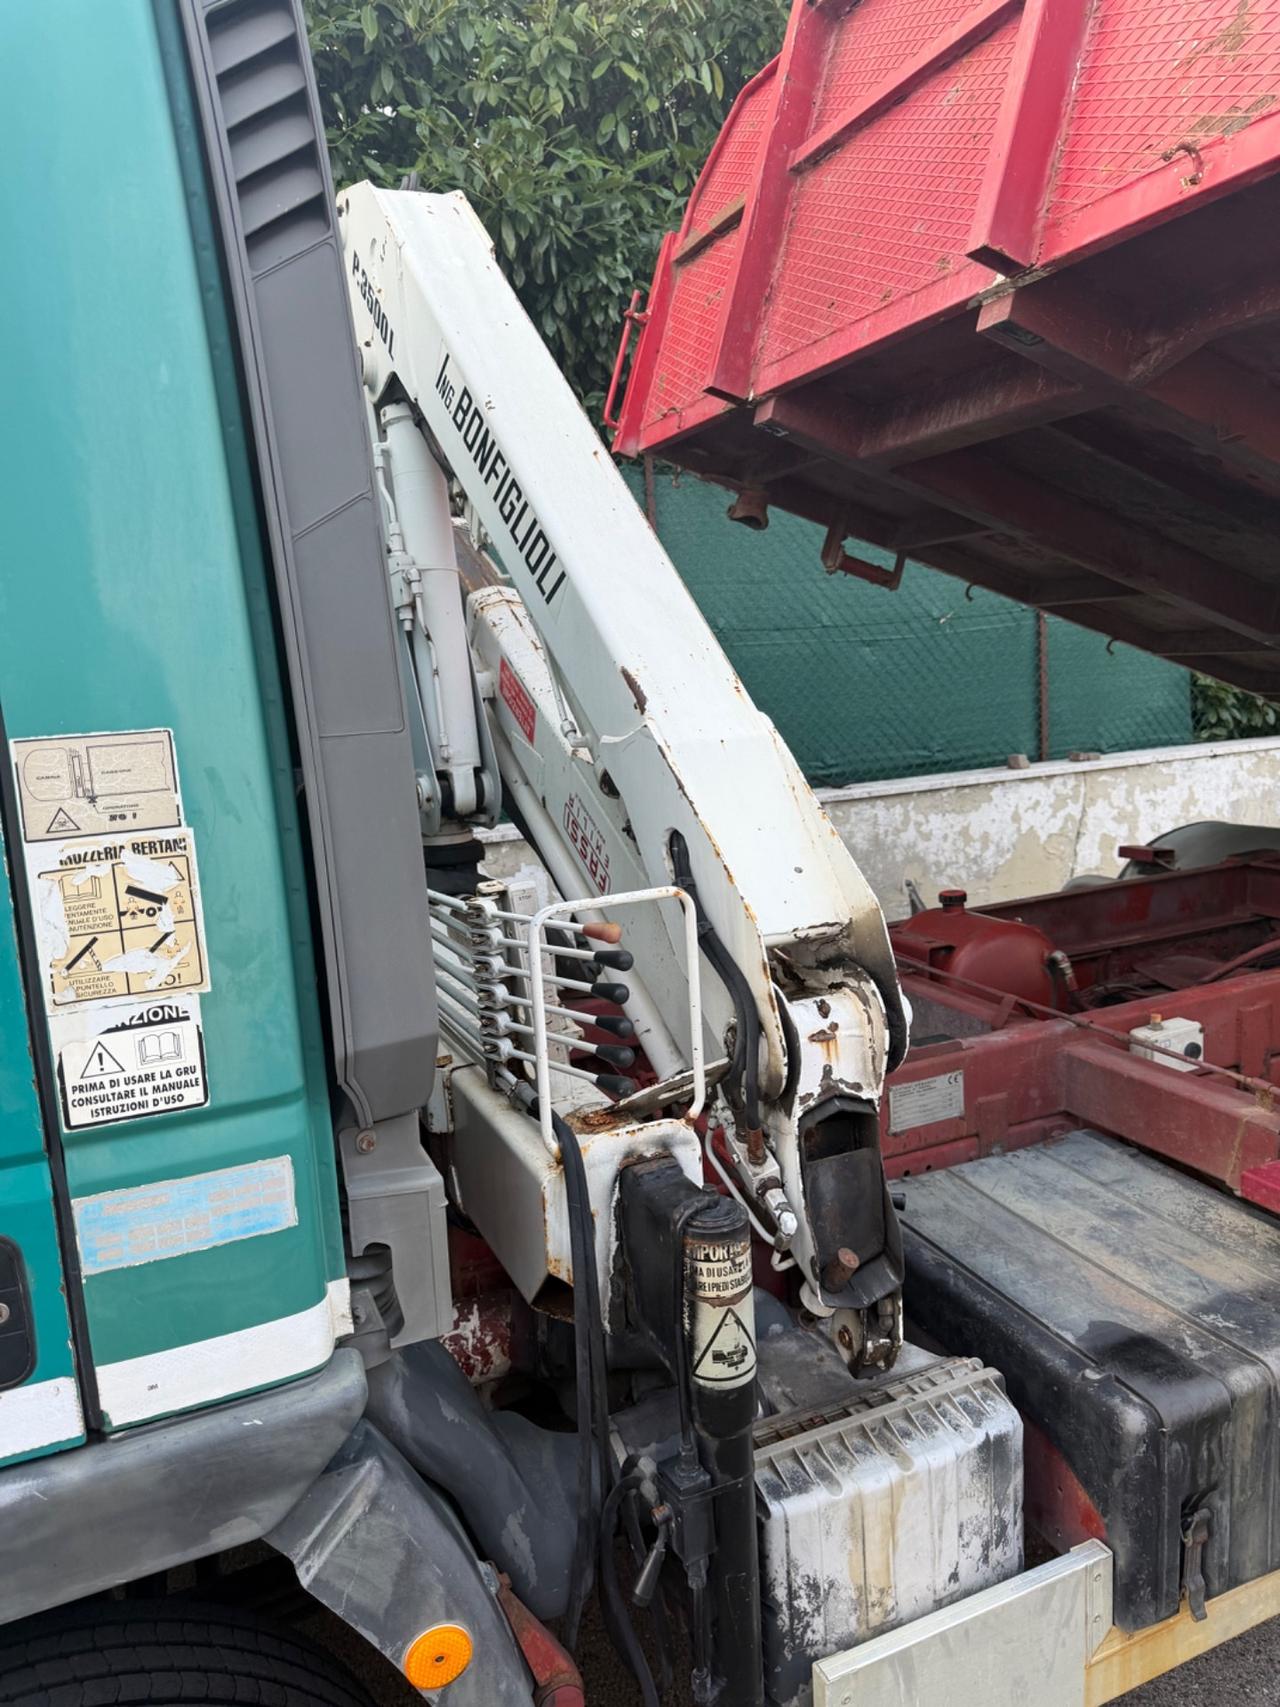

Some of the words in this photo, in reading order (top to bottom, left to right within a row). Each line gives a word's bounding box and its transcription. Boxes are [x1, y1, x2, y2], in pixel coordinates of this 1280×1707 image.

[453, 385, 566, 605] BONFIGLIOLI
[566, 811, 607, 893] FASSI
[64, 902, 96, 912] LEGGERE
[69, 976, 111, 986] UTILIZZARE
[71, 1081, 106, 1095] PRIMA
[109, 1078, 120, 1089] DI
[123, 1072, 156, 1086] USARE
[160, 1069, 172, 1080] LA
[175, 1065, 197, 1077] GRU
[71, 1089, 136, 1108] CONSULTARE
[140, 1087, 149, 1097] IL
[152, 1077, 200, 1095] MANUALE
[90, 1099, 149, 1119] ISTRUZIONI
[152, 1093, 185, 1107] D'USO
[706, 1267, 716, 1278] DI
